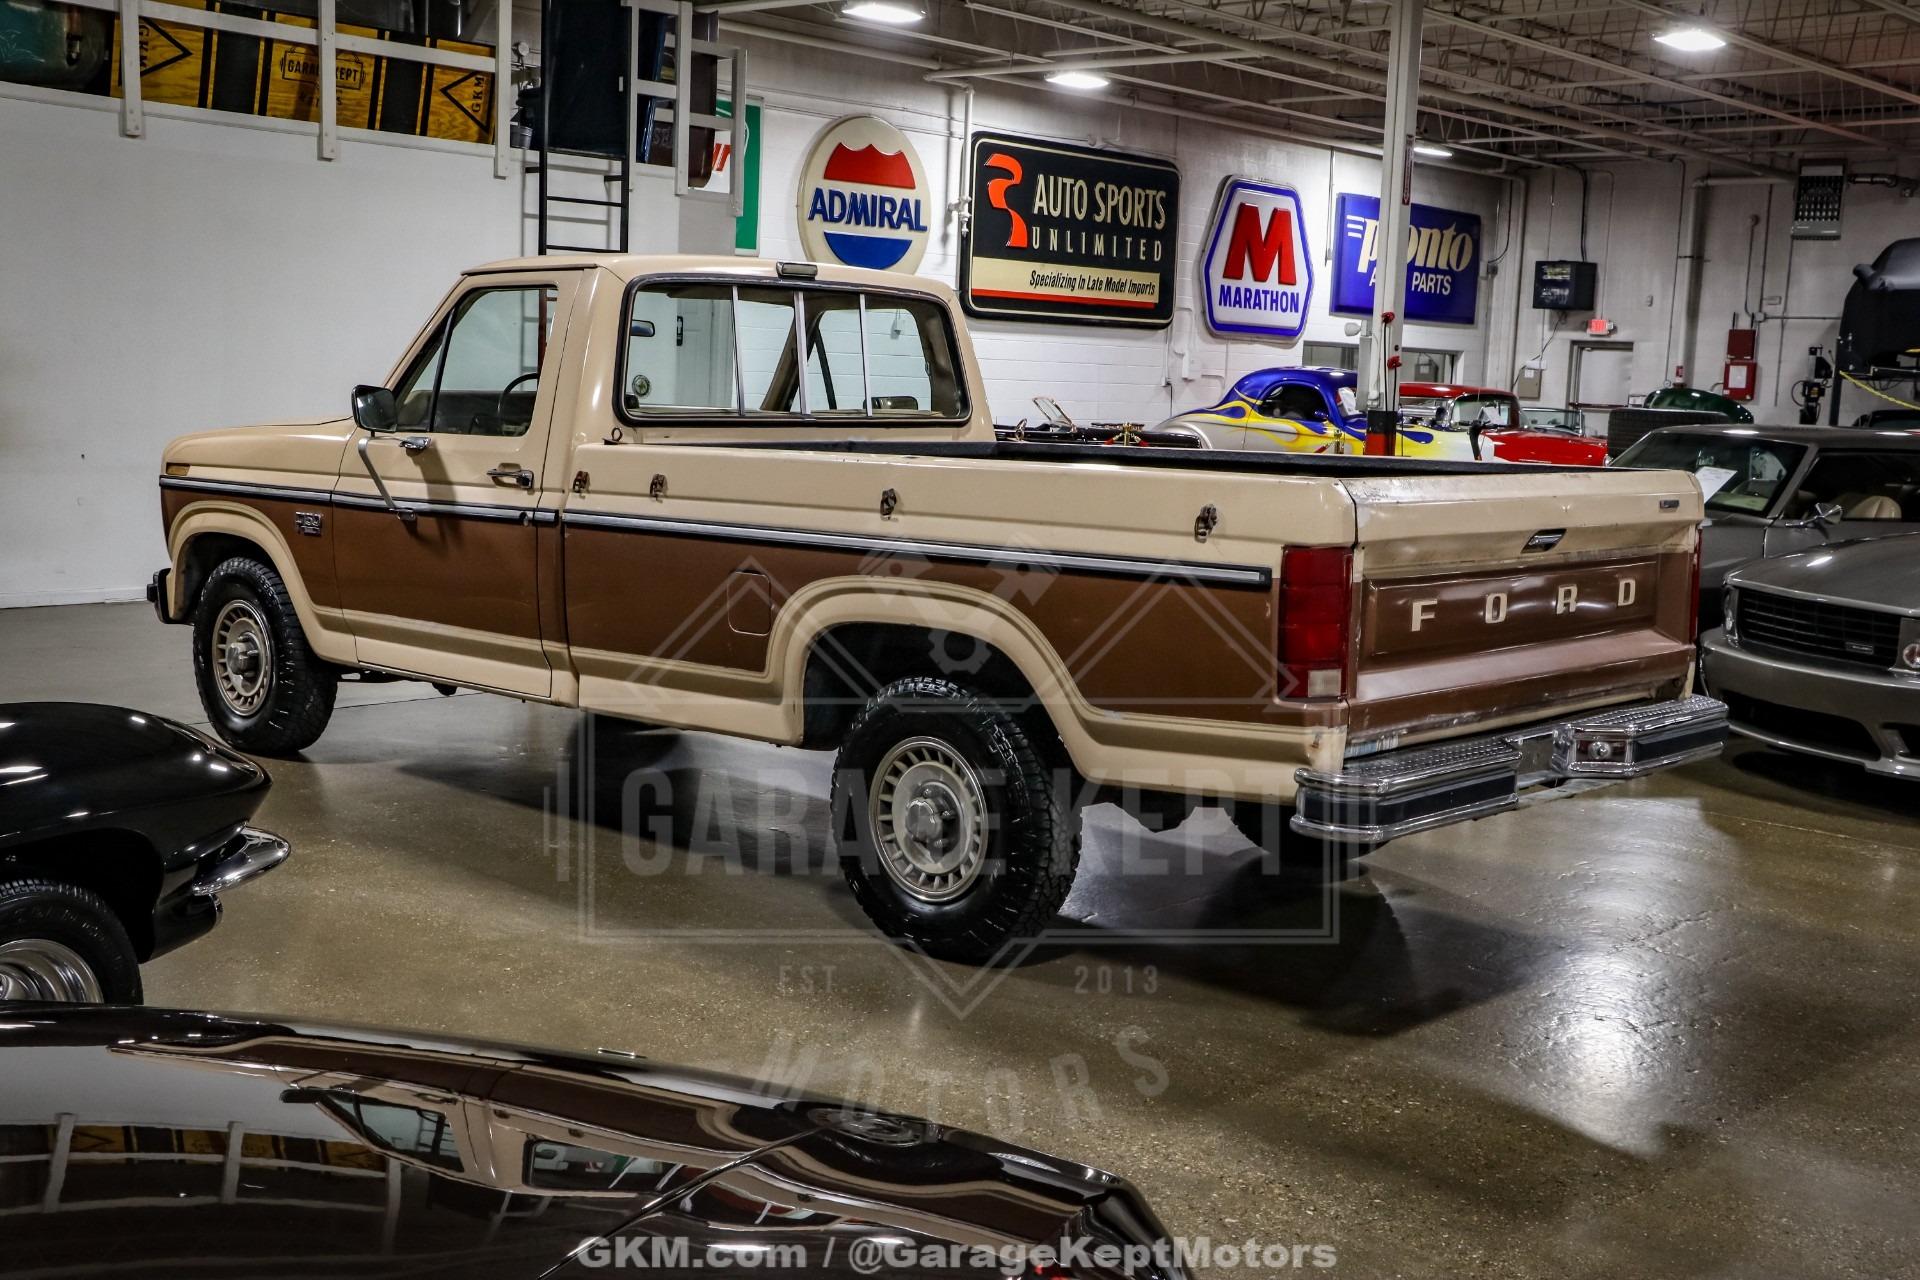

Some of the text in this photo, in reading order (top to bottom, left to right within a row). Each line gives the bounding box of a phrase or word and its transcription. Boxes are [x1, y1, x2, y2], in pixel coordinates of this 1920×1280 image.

[472, 75, 485, 112] GKM
[808, 187, 927, 232] ADMIRAL
[1033, 174, 1167, 230] AUTO SPORTS
[1032, 226, 1162, 262] UNLIMITED
[1223, 202, 1297, 286] M
[1029, 270, 1156, 296] Specializing In Late Model Imports
[1219, 284, 1300, 313] MARATHON
[1411, 272, 1452, 295] PARTS
[1411, 578, 1637, 632] FORD
